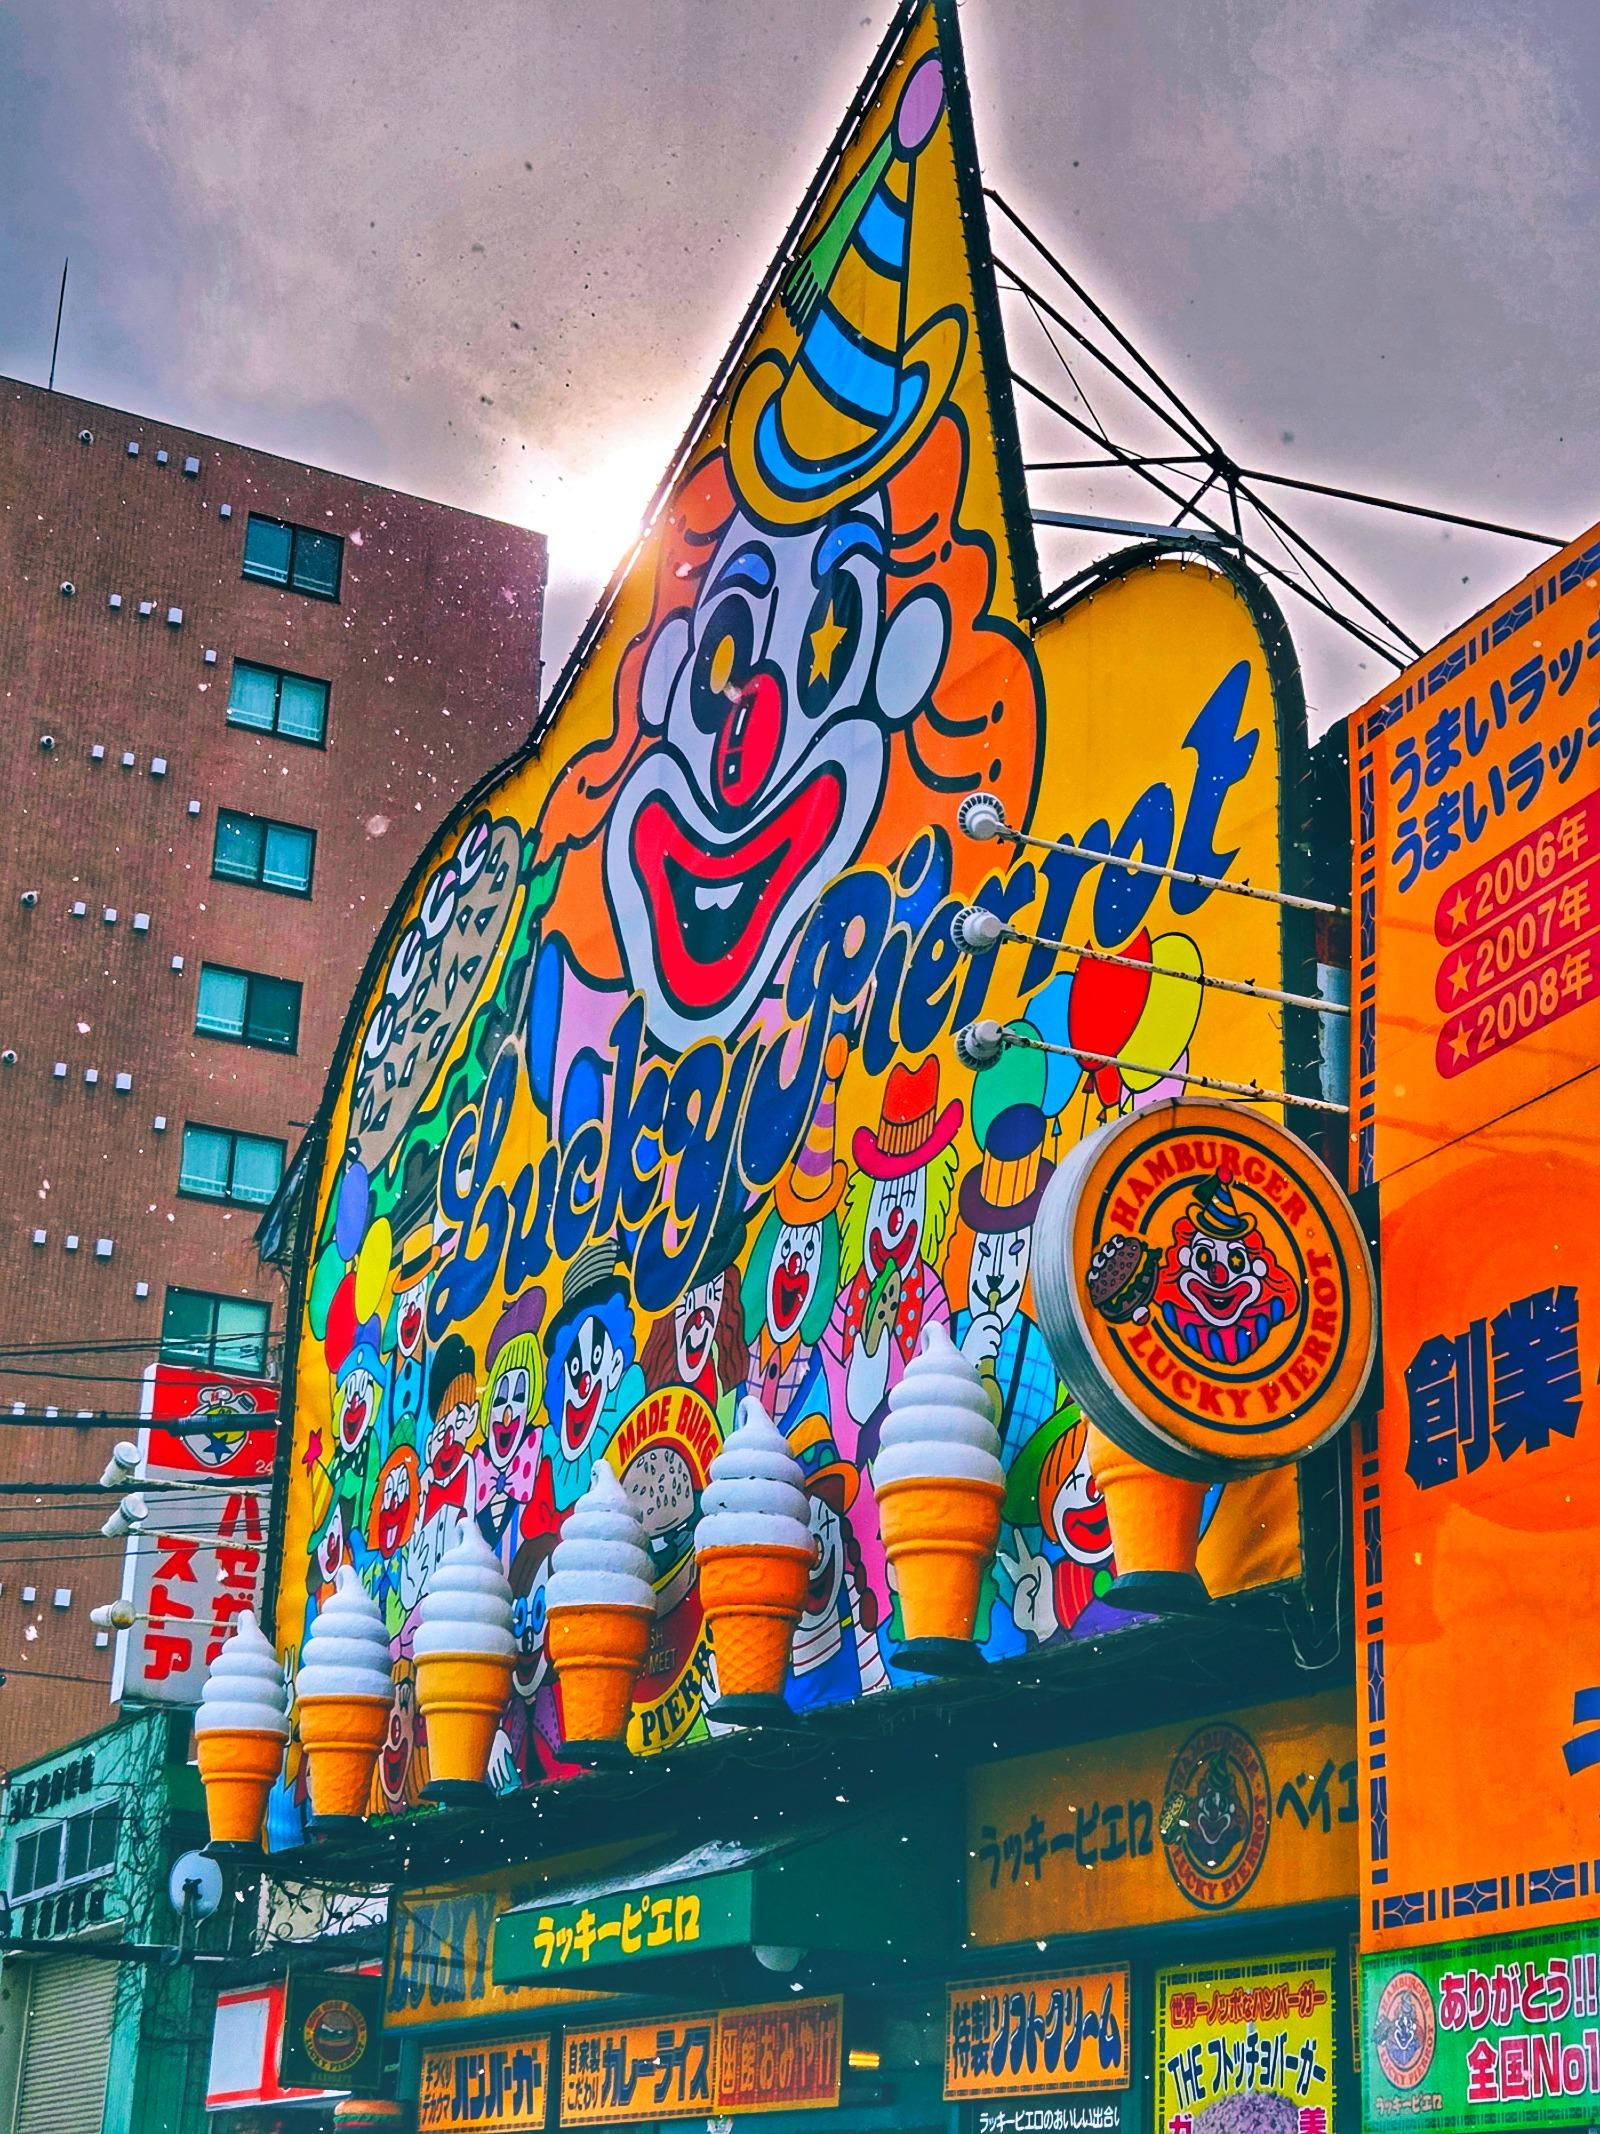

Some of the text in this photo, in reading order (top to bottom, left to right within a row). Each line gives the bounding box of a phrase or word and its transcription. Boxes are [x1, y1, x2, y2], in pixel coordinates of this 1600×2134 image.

[1473, 809, 1589, 922] 2006年
[1474, 878, 1591, 989] 2007年
[424, 660, 1261, 1343] Lucky Pierrot
[1476, 947, 1593, 1055] 2008年
[1110, 1141, 1309, 1232] HAMBURGER
[1127, 1249, 1338, 1419] LUCKY PIERROT
[617, 1393, 672, 1465] MADE
[144, 1536, 199, 1681] ストア
[205, 1494, 262, 1666] ハセガ
[1170, 1795, 1266, 1901] LUCKY PIERROT
[533, 1894, 701, 1969] ラッキーピエロ
[600, 2026, 712, 2109] カレーライス
[952, 1982, 1122, 2080] 特製ソフトクリーム
[1167, 2031, 1327, 2111] THE フトッチョバーガー
[452, 2047, 542, 2122] ハンバーガー
[567, 2075, 599, 2111] こだわり
